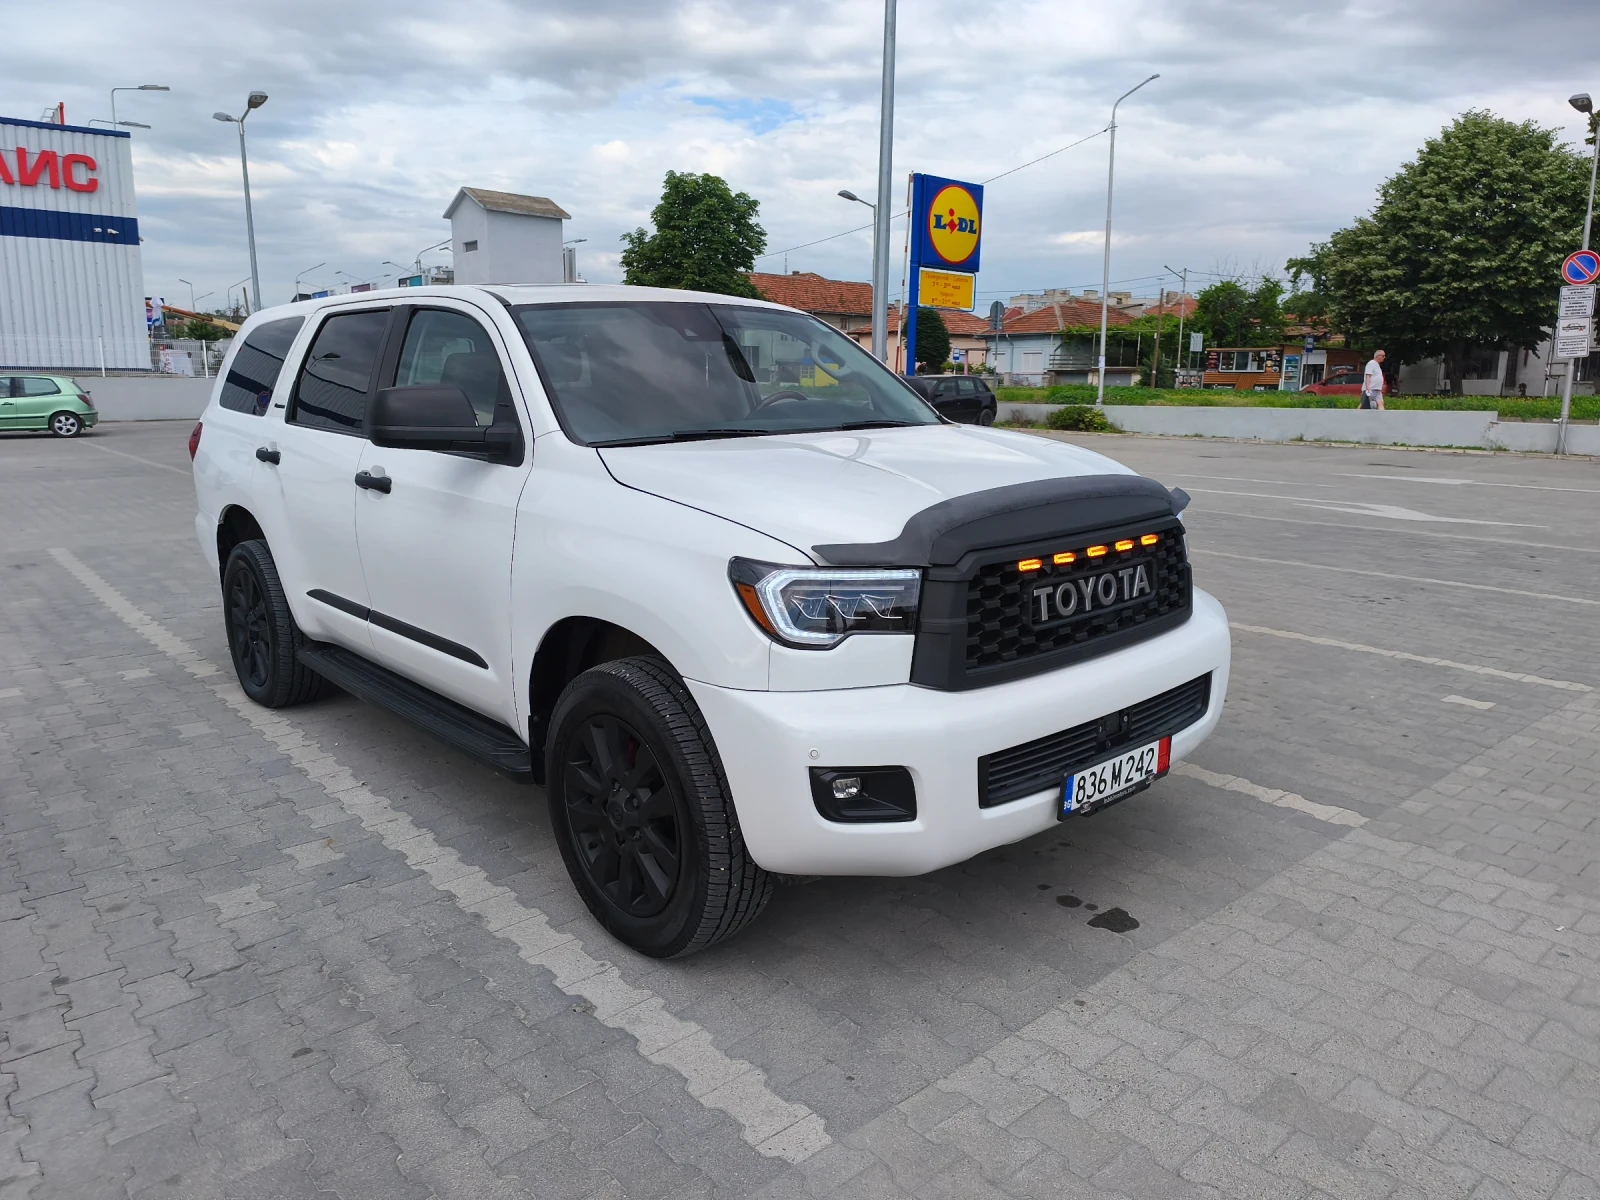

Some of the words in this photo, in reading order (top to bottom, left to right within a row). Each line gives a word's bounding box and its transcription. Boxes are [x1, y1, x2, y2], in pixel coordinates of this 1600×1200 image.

[1033, 564, 1150, 621] TOYOTA
[1075, 766, 1107, 805] 836
[1124, 747, 1155, 784] 242
